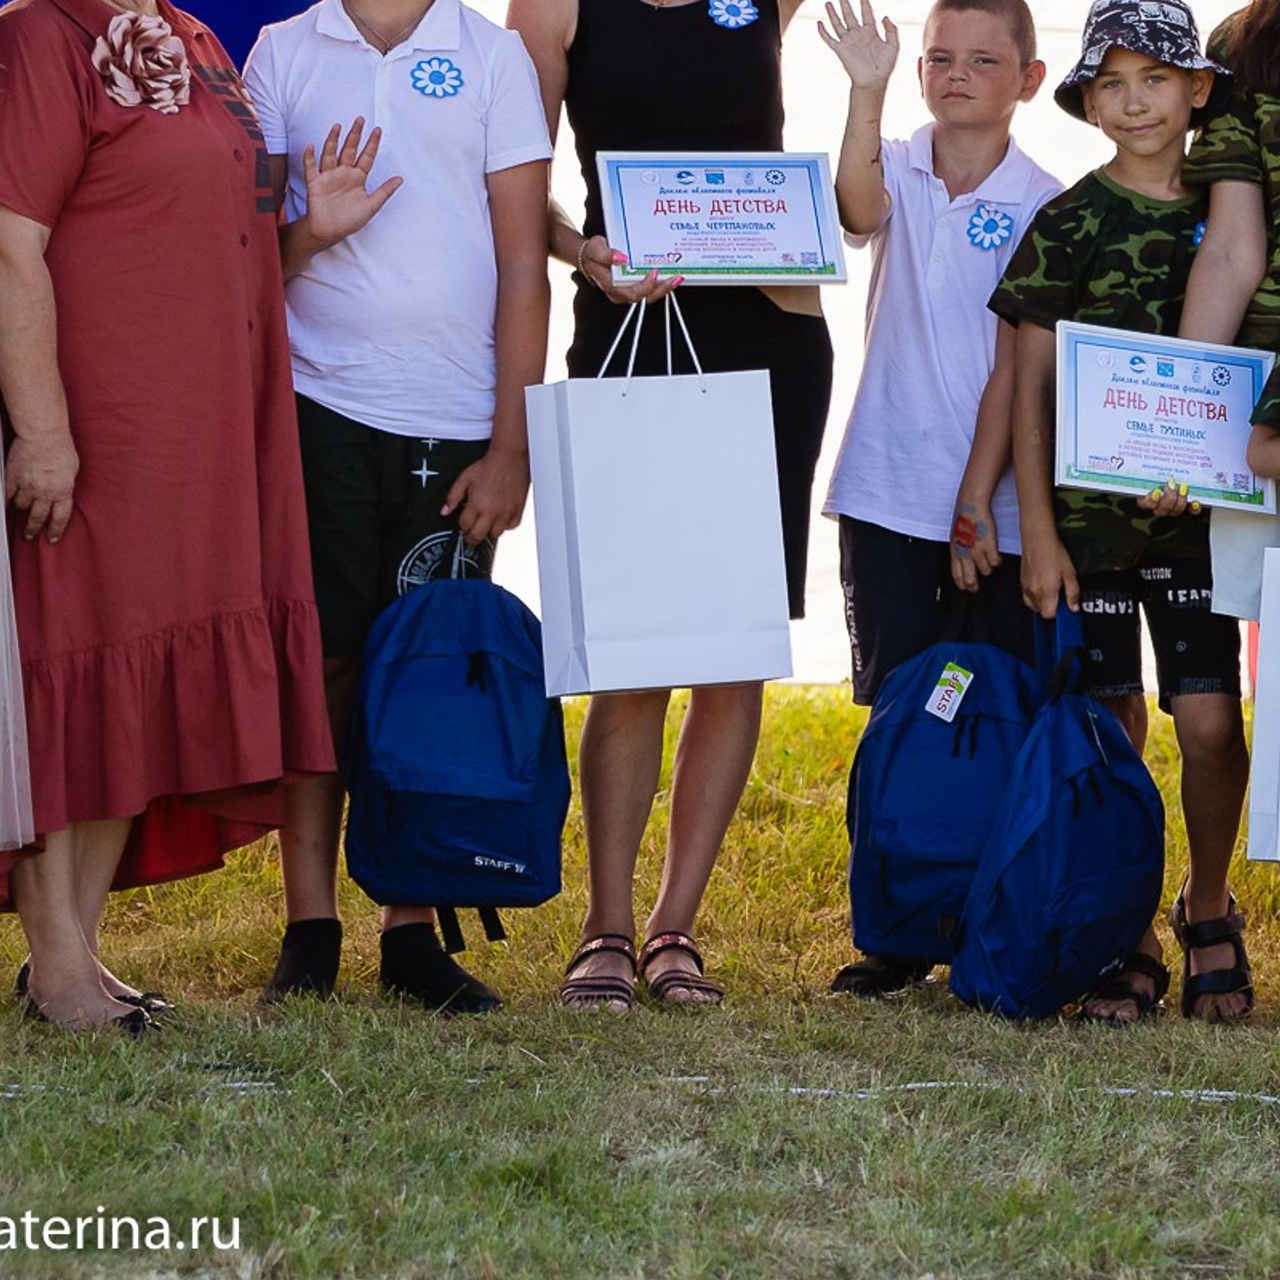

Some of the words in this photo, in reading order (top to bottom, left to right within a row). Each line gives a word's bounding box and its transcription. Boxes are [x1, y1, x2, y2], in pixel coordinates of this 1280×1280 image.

[653, 199, 701, 216] ДЕНЬ
[710, 199, 788, 216] ДЕТСТВА
[1103, 387, 1149, 411] ДЕНЬ
[1155, 395, 1229, 422] ДЕТСТВА
[1126, 419, 1154, 434] СЕМЬЕ
[936, 672, 960, 713] STAFF
[474, 855, 512, 871] STAFF
